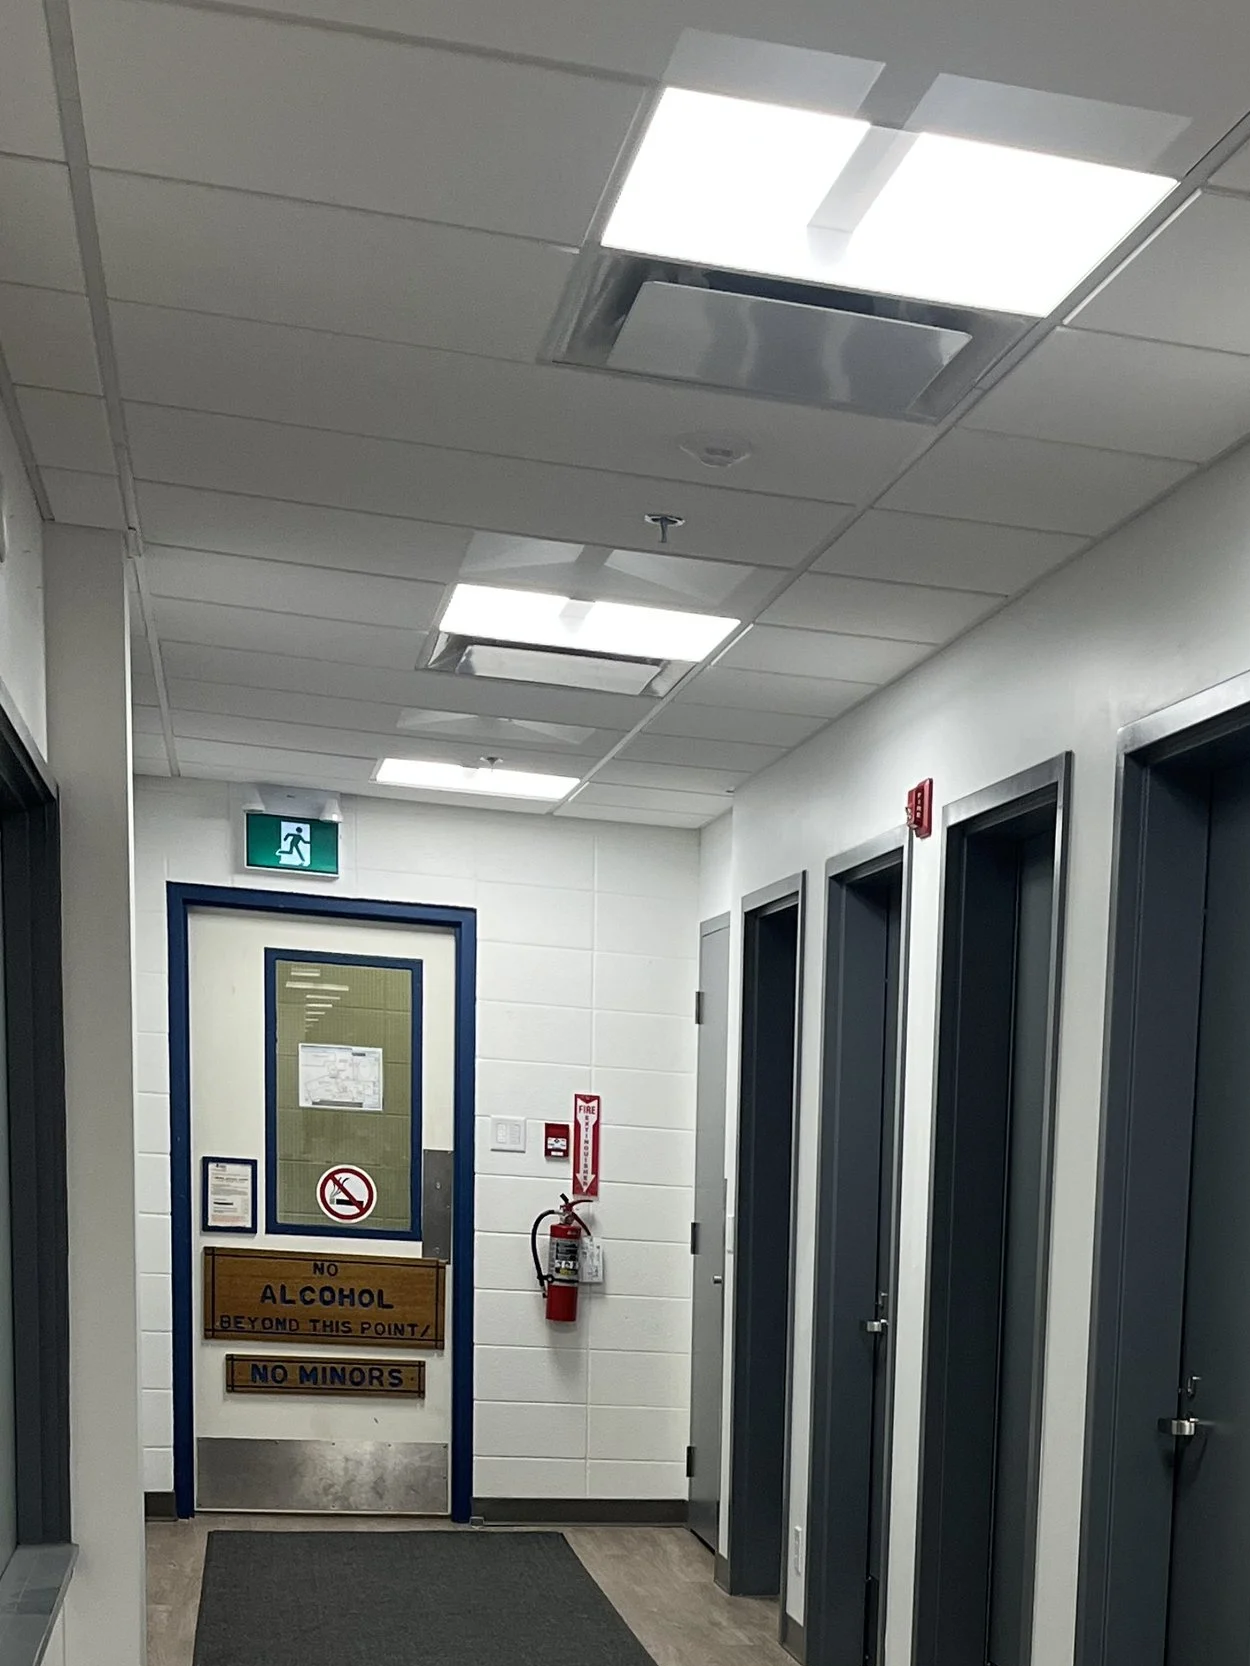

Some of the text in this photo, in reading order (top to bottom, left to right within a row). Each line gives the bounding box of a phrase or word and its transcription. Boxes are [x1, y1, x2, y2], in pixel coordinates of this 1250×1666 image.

[578, 1104, 596, 1115] FIRE
[312, 1262, 339, 1277] NO
[260, 1284, 394, 1309] ALCOHOL
[219, 1314, 300, 1332] BEYOND
[309, 1319, 353, 1334] THIS
[251, 1363, 404, 1388] NO MINORS
